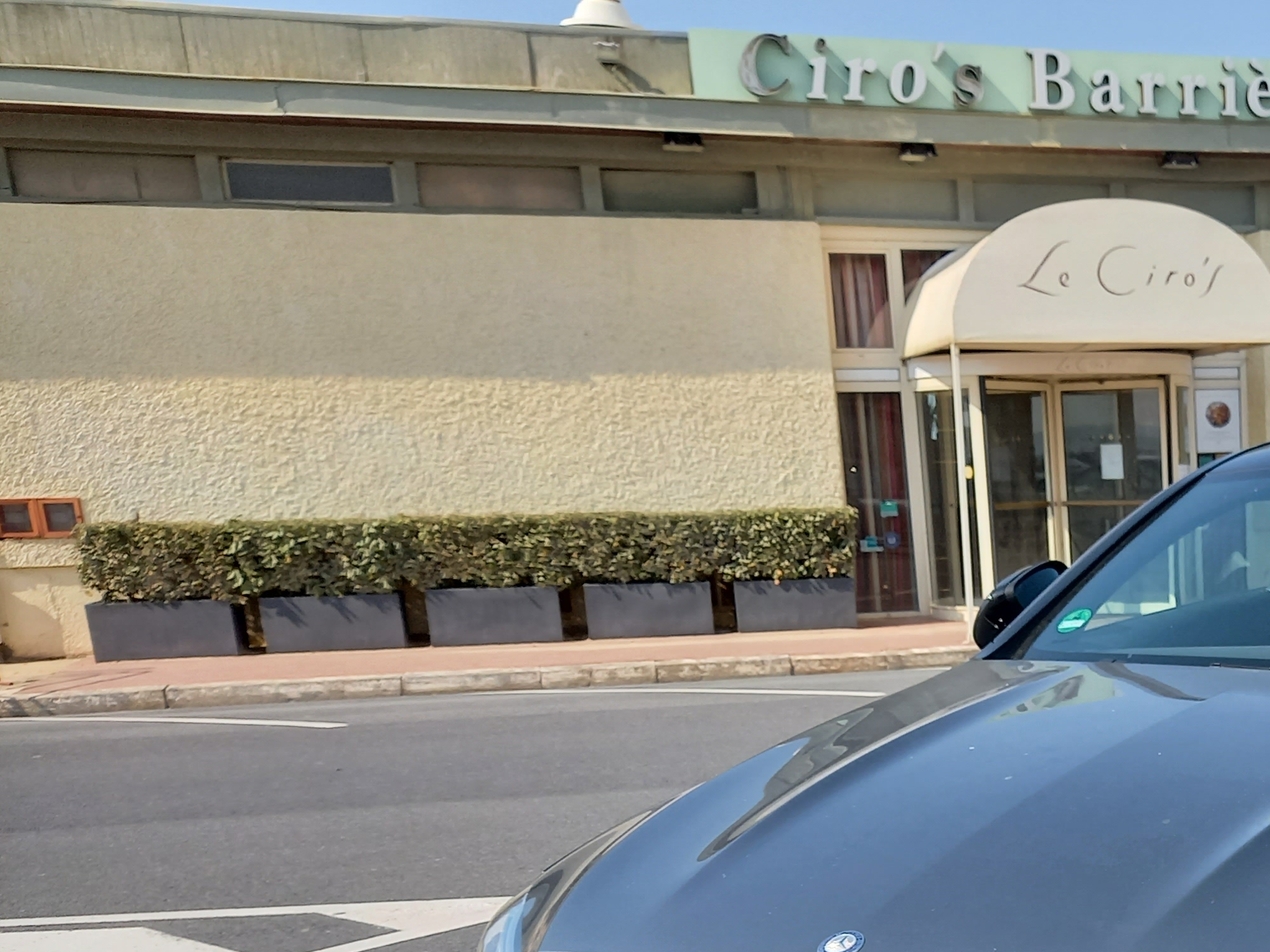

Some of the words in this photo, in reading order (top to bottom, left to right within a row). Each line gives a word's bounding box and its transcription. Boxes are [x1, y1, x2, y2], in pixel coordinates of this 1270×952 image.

[738, 33, 986, 108] Ciro's
[1017, 240, 1070, 297] Le
[1097, 245, 1234, 298] Ciro's
